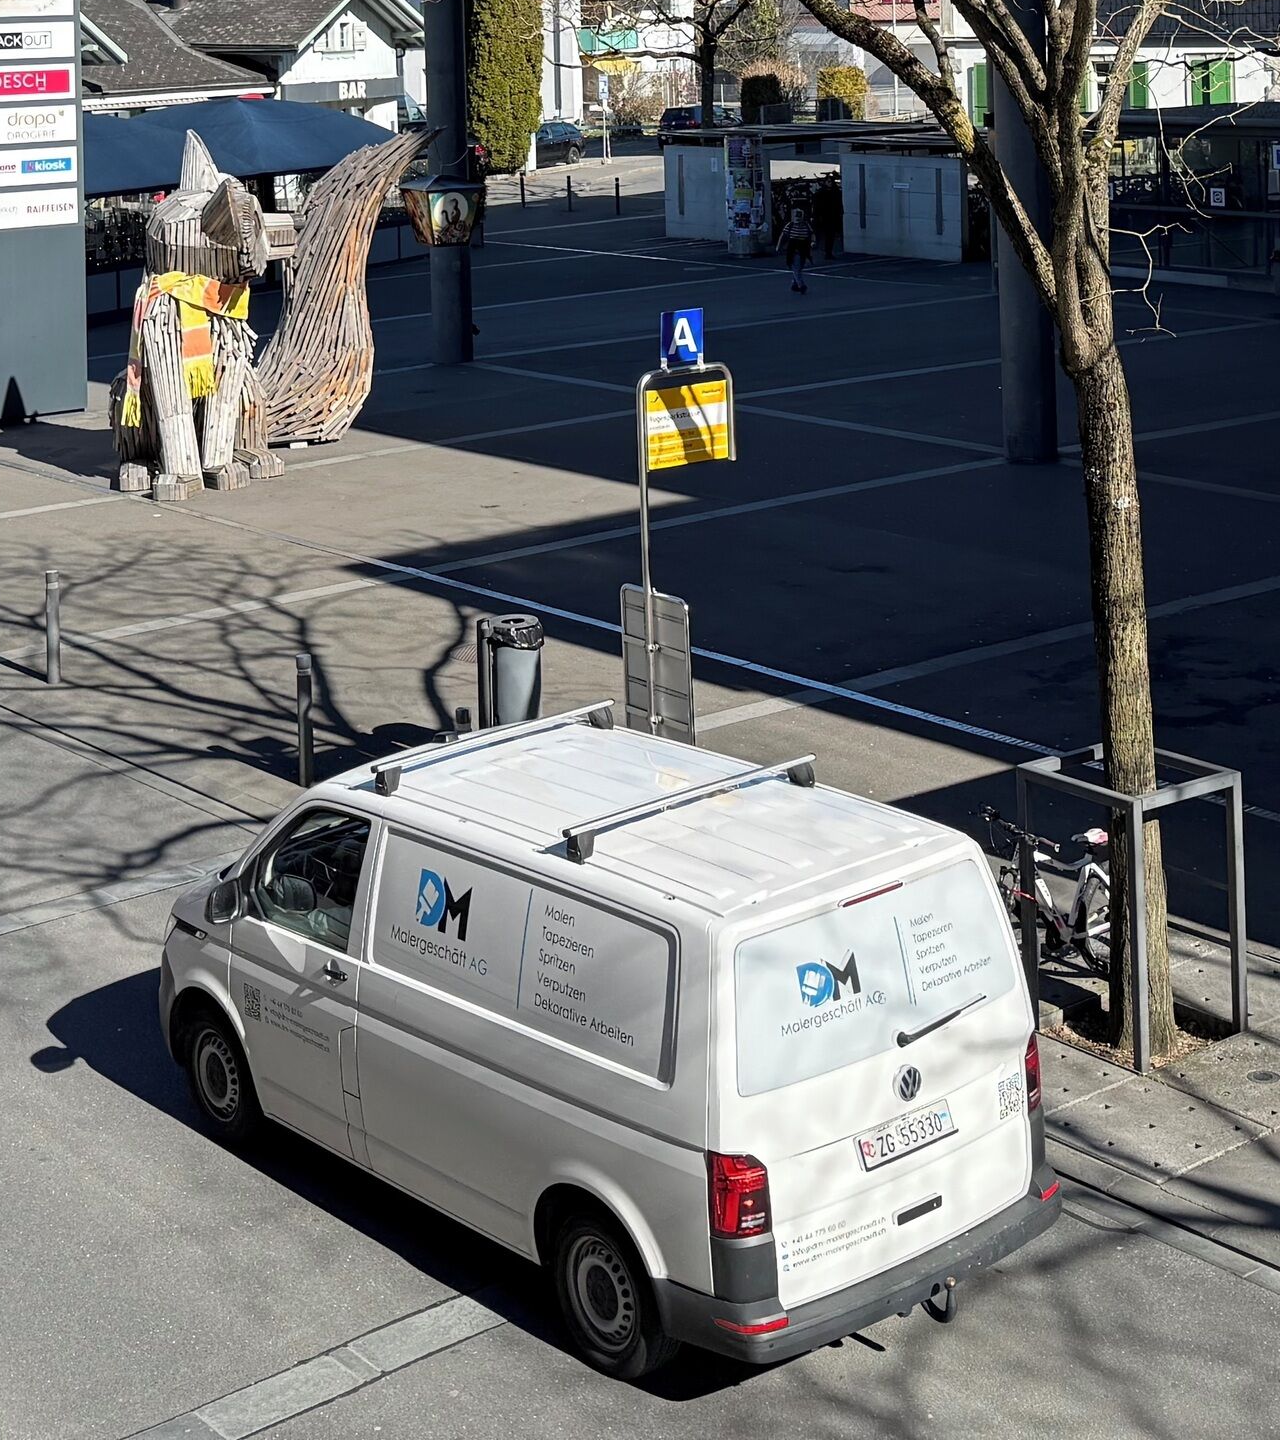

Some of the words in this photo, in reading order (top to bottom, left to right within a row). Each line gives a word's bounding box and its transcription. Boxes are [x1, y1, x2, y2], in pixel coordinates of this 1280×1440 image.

[338, 81, 367, 100] BAR
[7, 112, 56, 129] dropa
[6, 129, 56, 140] DROGERIE
[34, 160, 66, 171] kiosk
[26, 202, 74, 214] RAIFFEISEN
[668, 317, 698, 355] A
[543, 904, 575, 928] Malen
[389, 923, 467, 967] Malergeschäft
[469, 957, 488, 976] AG
[541, 925, 595, 959] Tapezieren
[538, 948, 576, 976] Spritzen
[536, 971, 587, 1004] Verputzen
[866, 991, 887, 1007] AG
[534, 992, 587, 1027] Dekorative
[589, 1016, 634, 1048] Arbeiten
[876, 1133, 895, 1158] ZG
[899, 1112, 943, 1147] 55330
